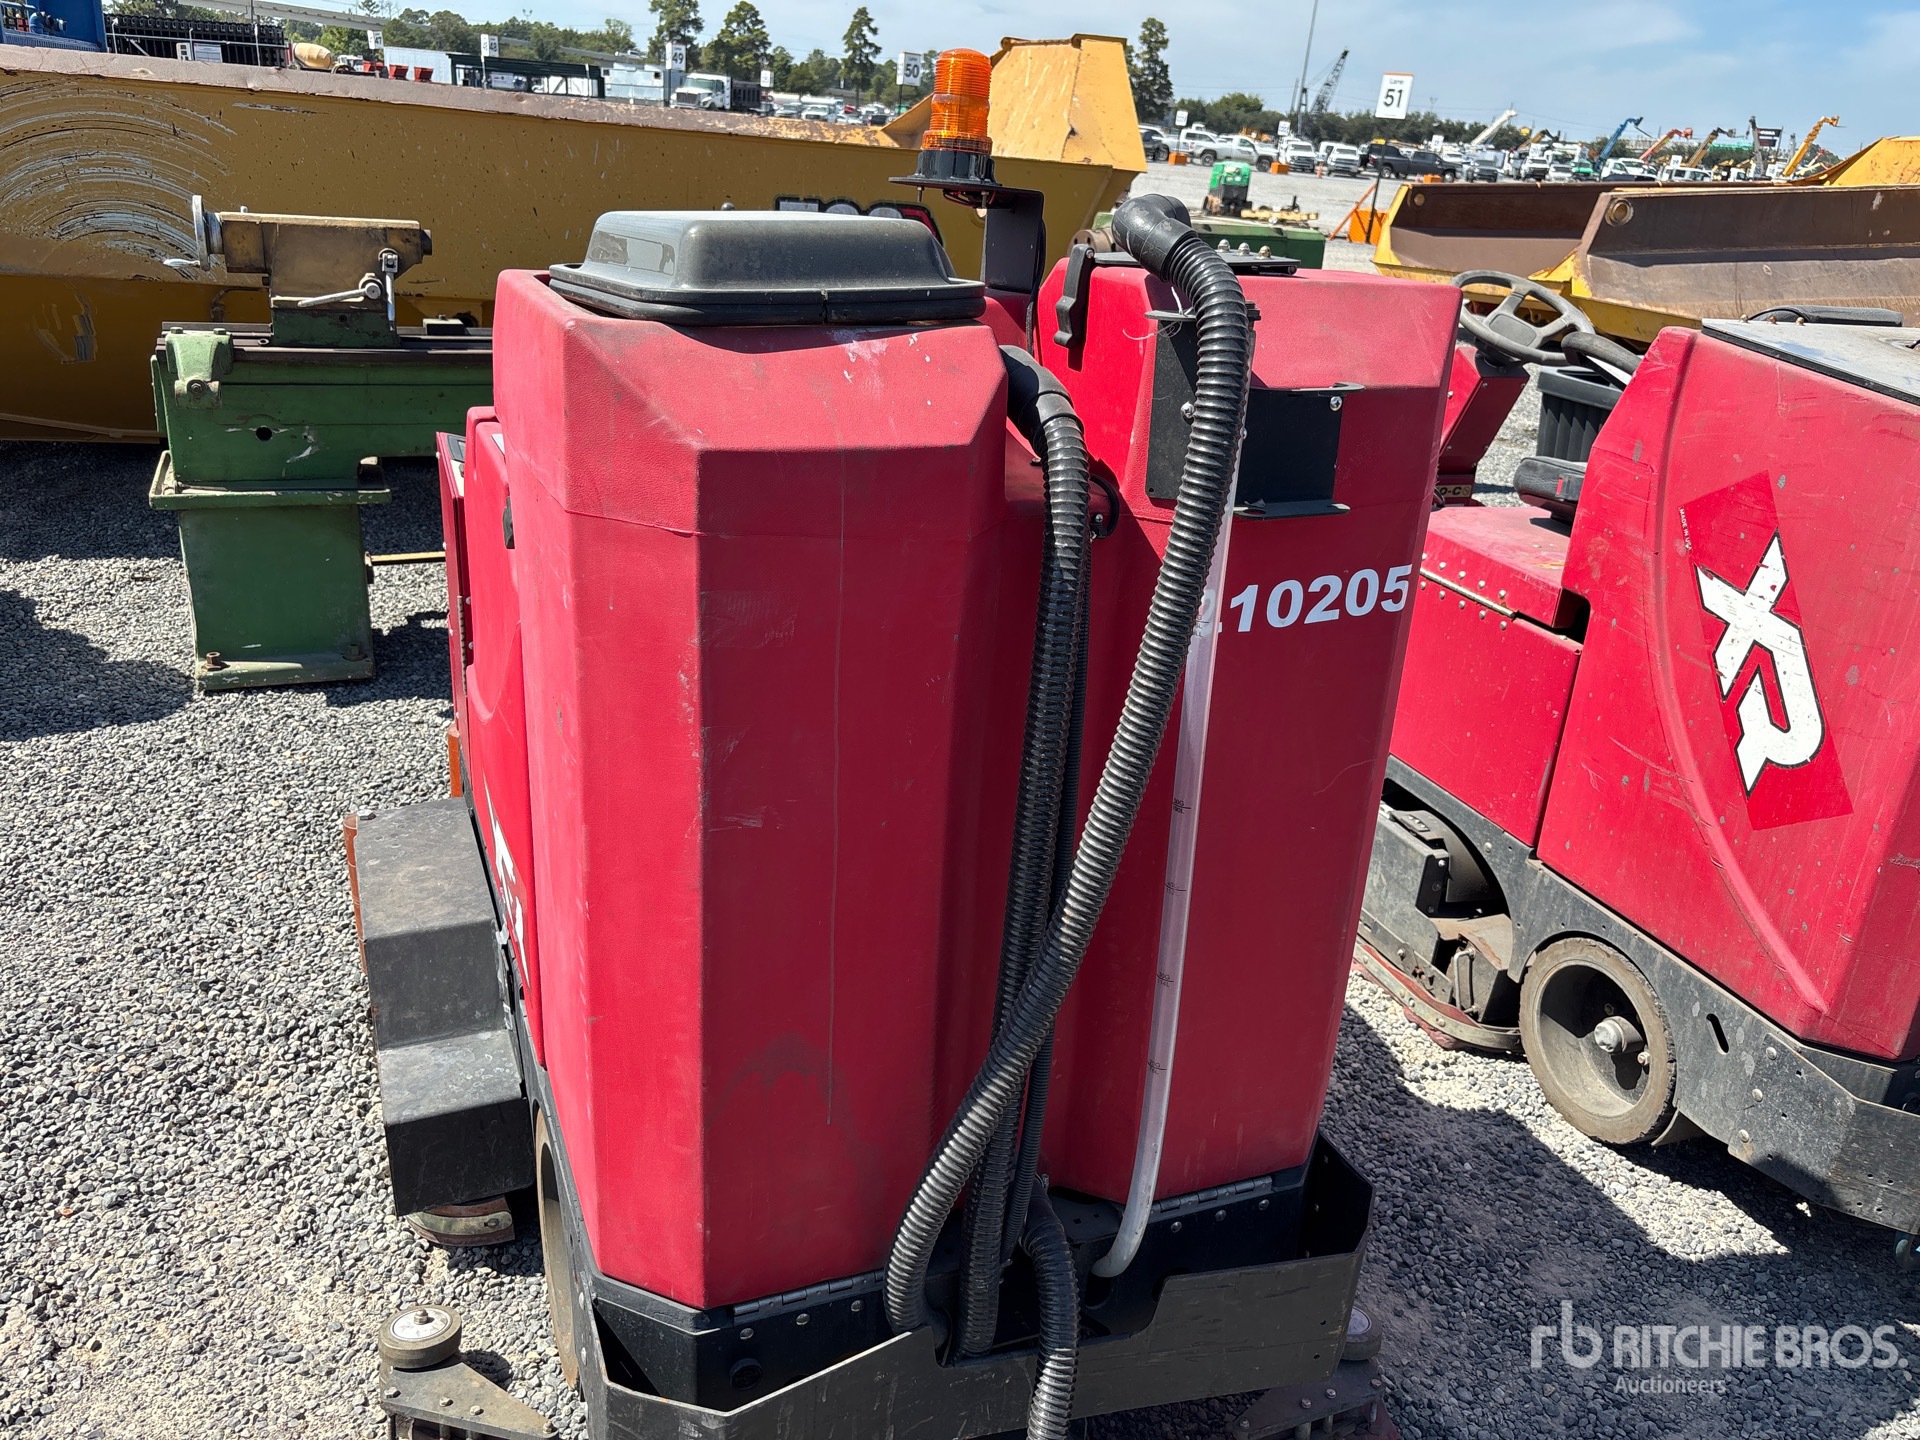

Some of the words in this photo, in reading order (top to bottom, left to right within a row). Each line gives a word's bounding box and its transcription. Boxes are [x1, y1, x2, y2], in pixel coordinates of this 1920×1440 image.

[672, 52, 684, 64] 49
[905, 63, 920, 78] 50
[1383, 88, 1403, 108] 51
[1679, 508, 1688, 528] MADE
[1683, 528, 1690, 537] IN
